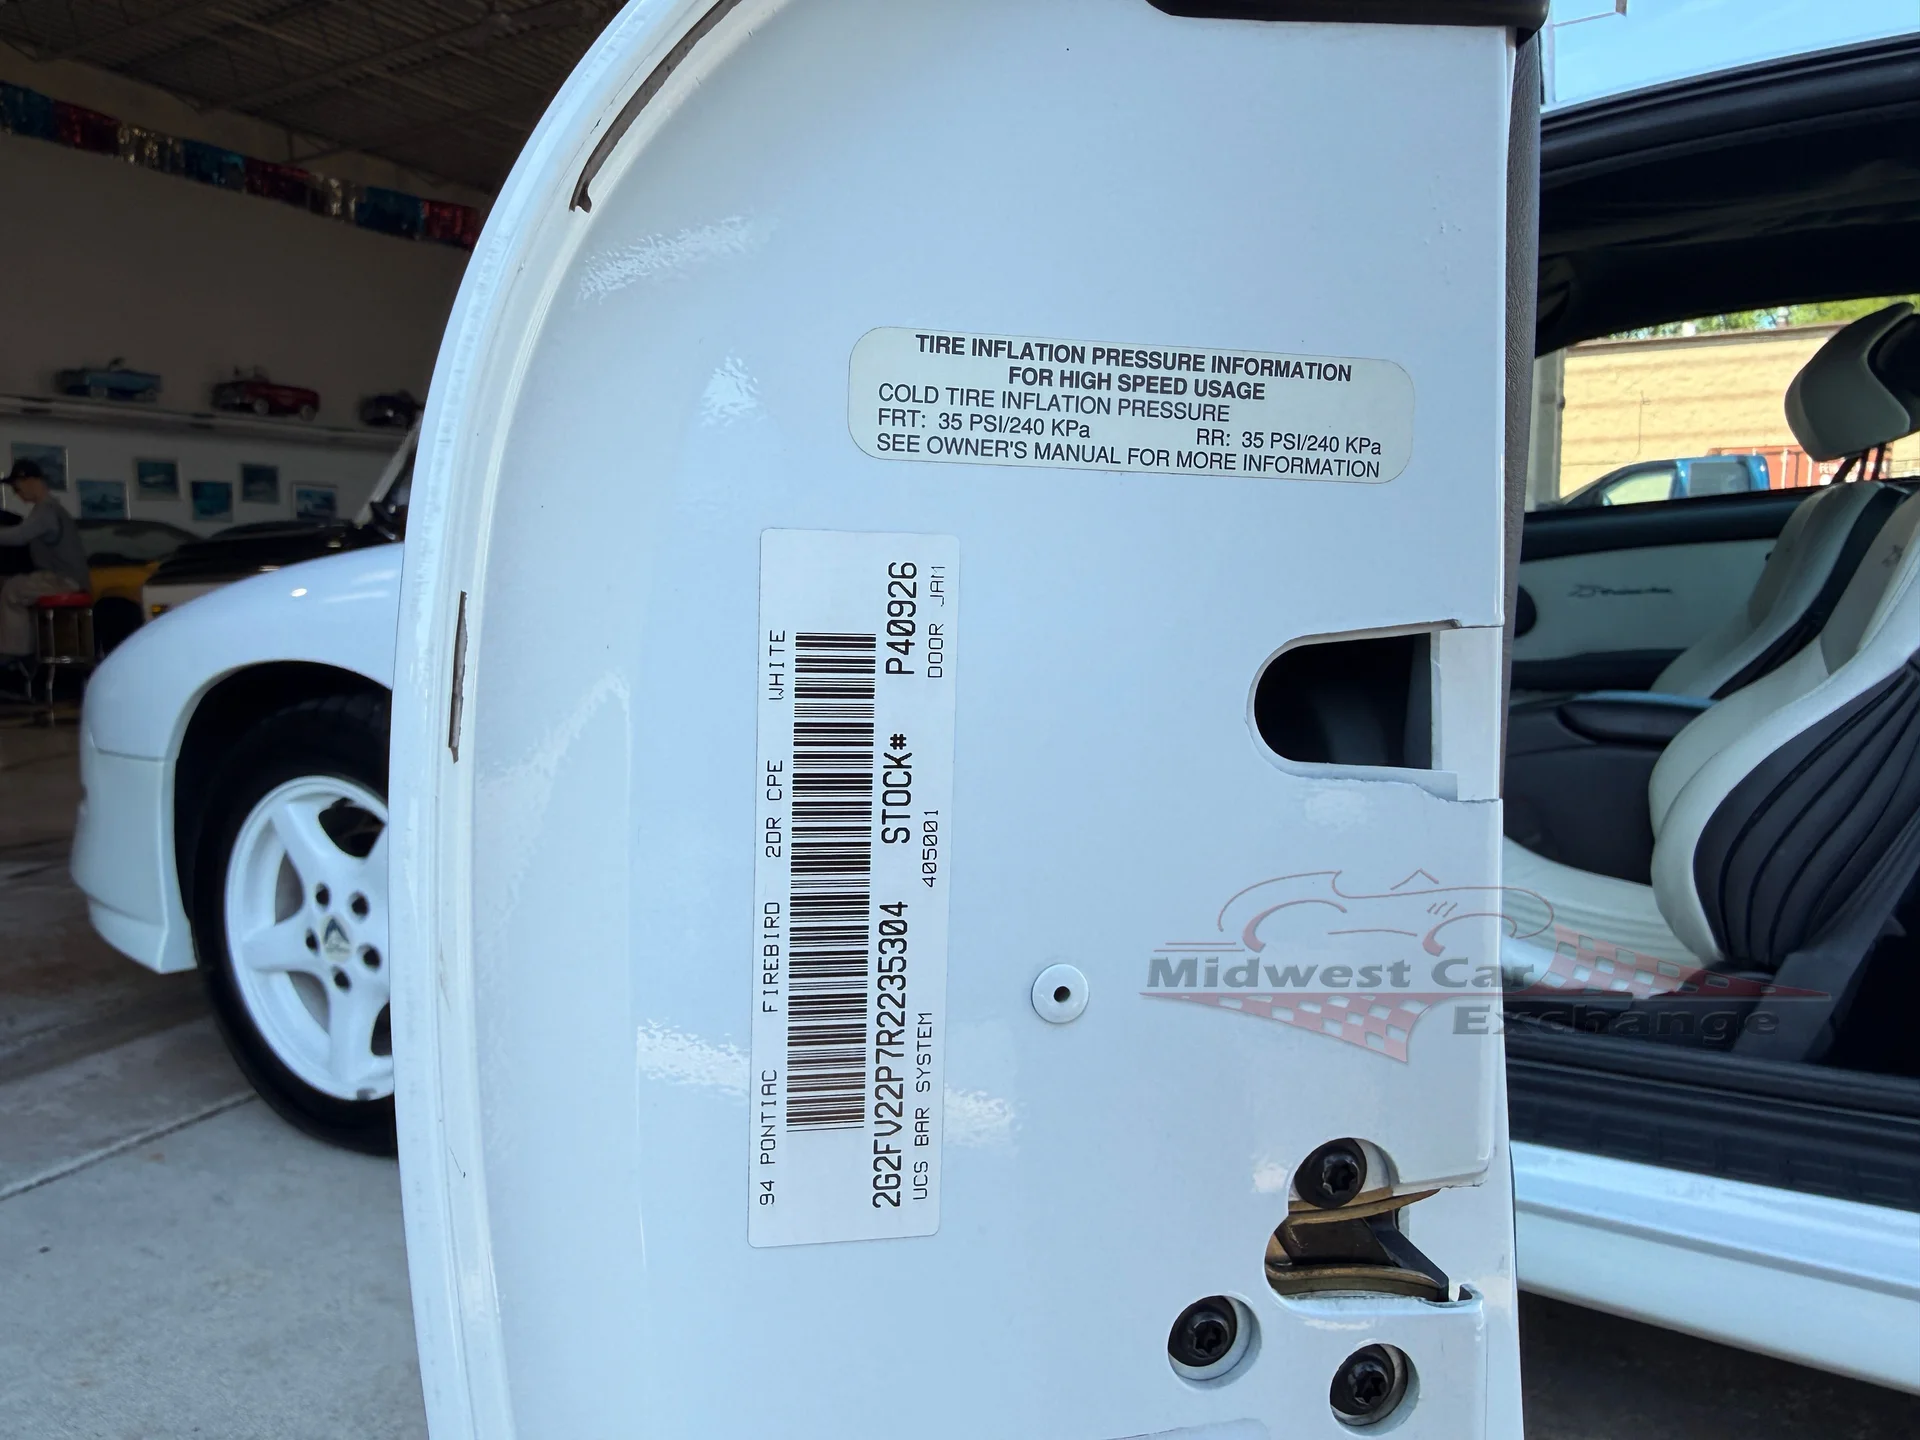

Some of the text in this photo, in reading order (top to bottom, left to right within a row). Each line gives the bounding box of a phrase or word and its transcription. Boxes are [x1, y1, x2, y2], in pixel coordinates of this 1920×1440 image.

[915, 334, 1352, 382] TIRE INFLATION PRESSURE INFORMATION
[1008, 366, 1265, 400] FOR HIGH SPEED USAGE
[878, 383, 1230, 422] COLD TIRE INFLATION PRESSURE
[878, 408, 1091, 439] FRT: 35 PSI/240 KPa
[876, 433, 1380, 478] SEE OWNER'S MANUAL FOR MORE INFORMATION
[1196, 428, 1382, 455] RR: 35 PSI/240 KPa
[928, 566, 946, 678] DOOR JAM
[881, 562, 917, 843] STOCK# P40926
[922, 810, 939, 888] 405001
[759, 630, 785, 1205] 94 PONTIAC FIREBIRD 2DR CPE WHITE
[872, 901, 908, 1208] 2G2FV22P7R2235304
[913, 1012, 933, 1200] UCS BAR SYSTEM
